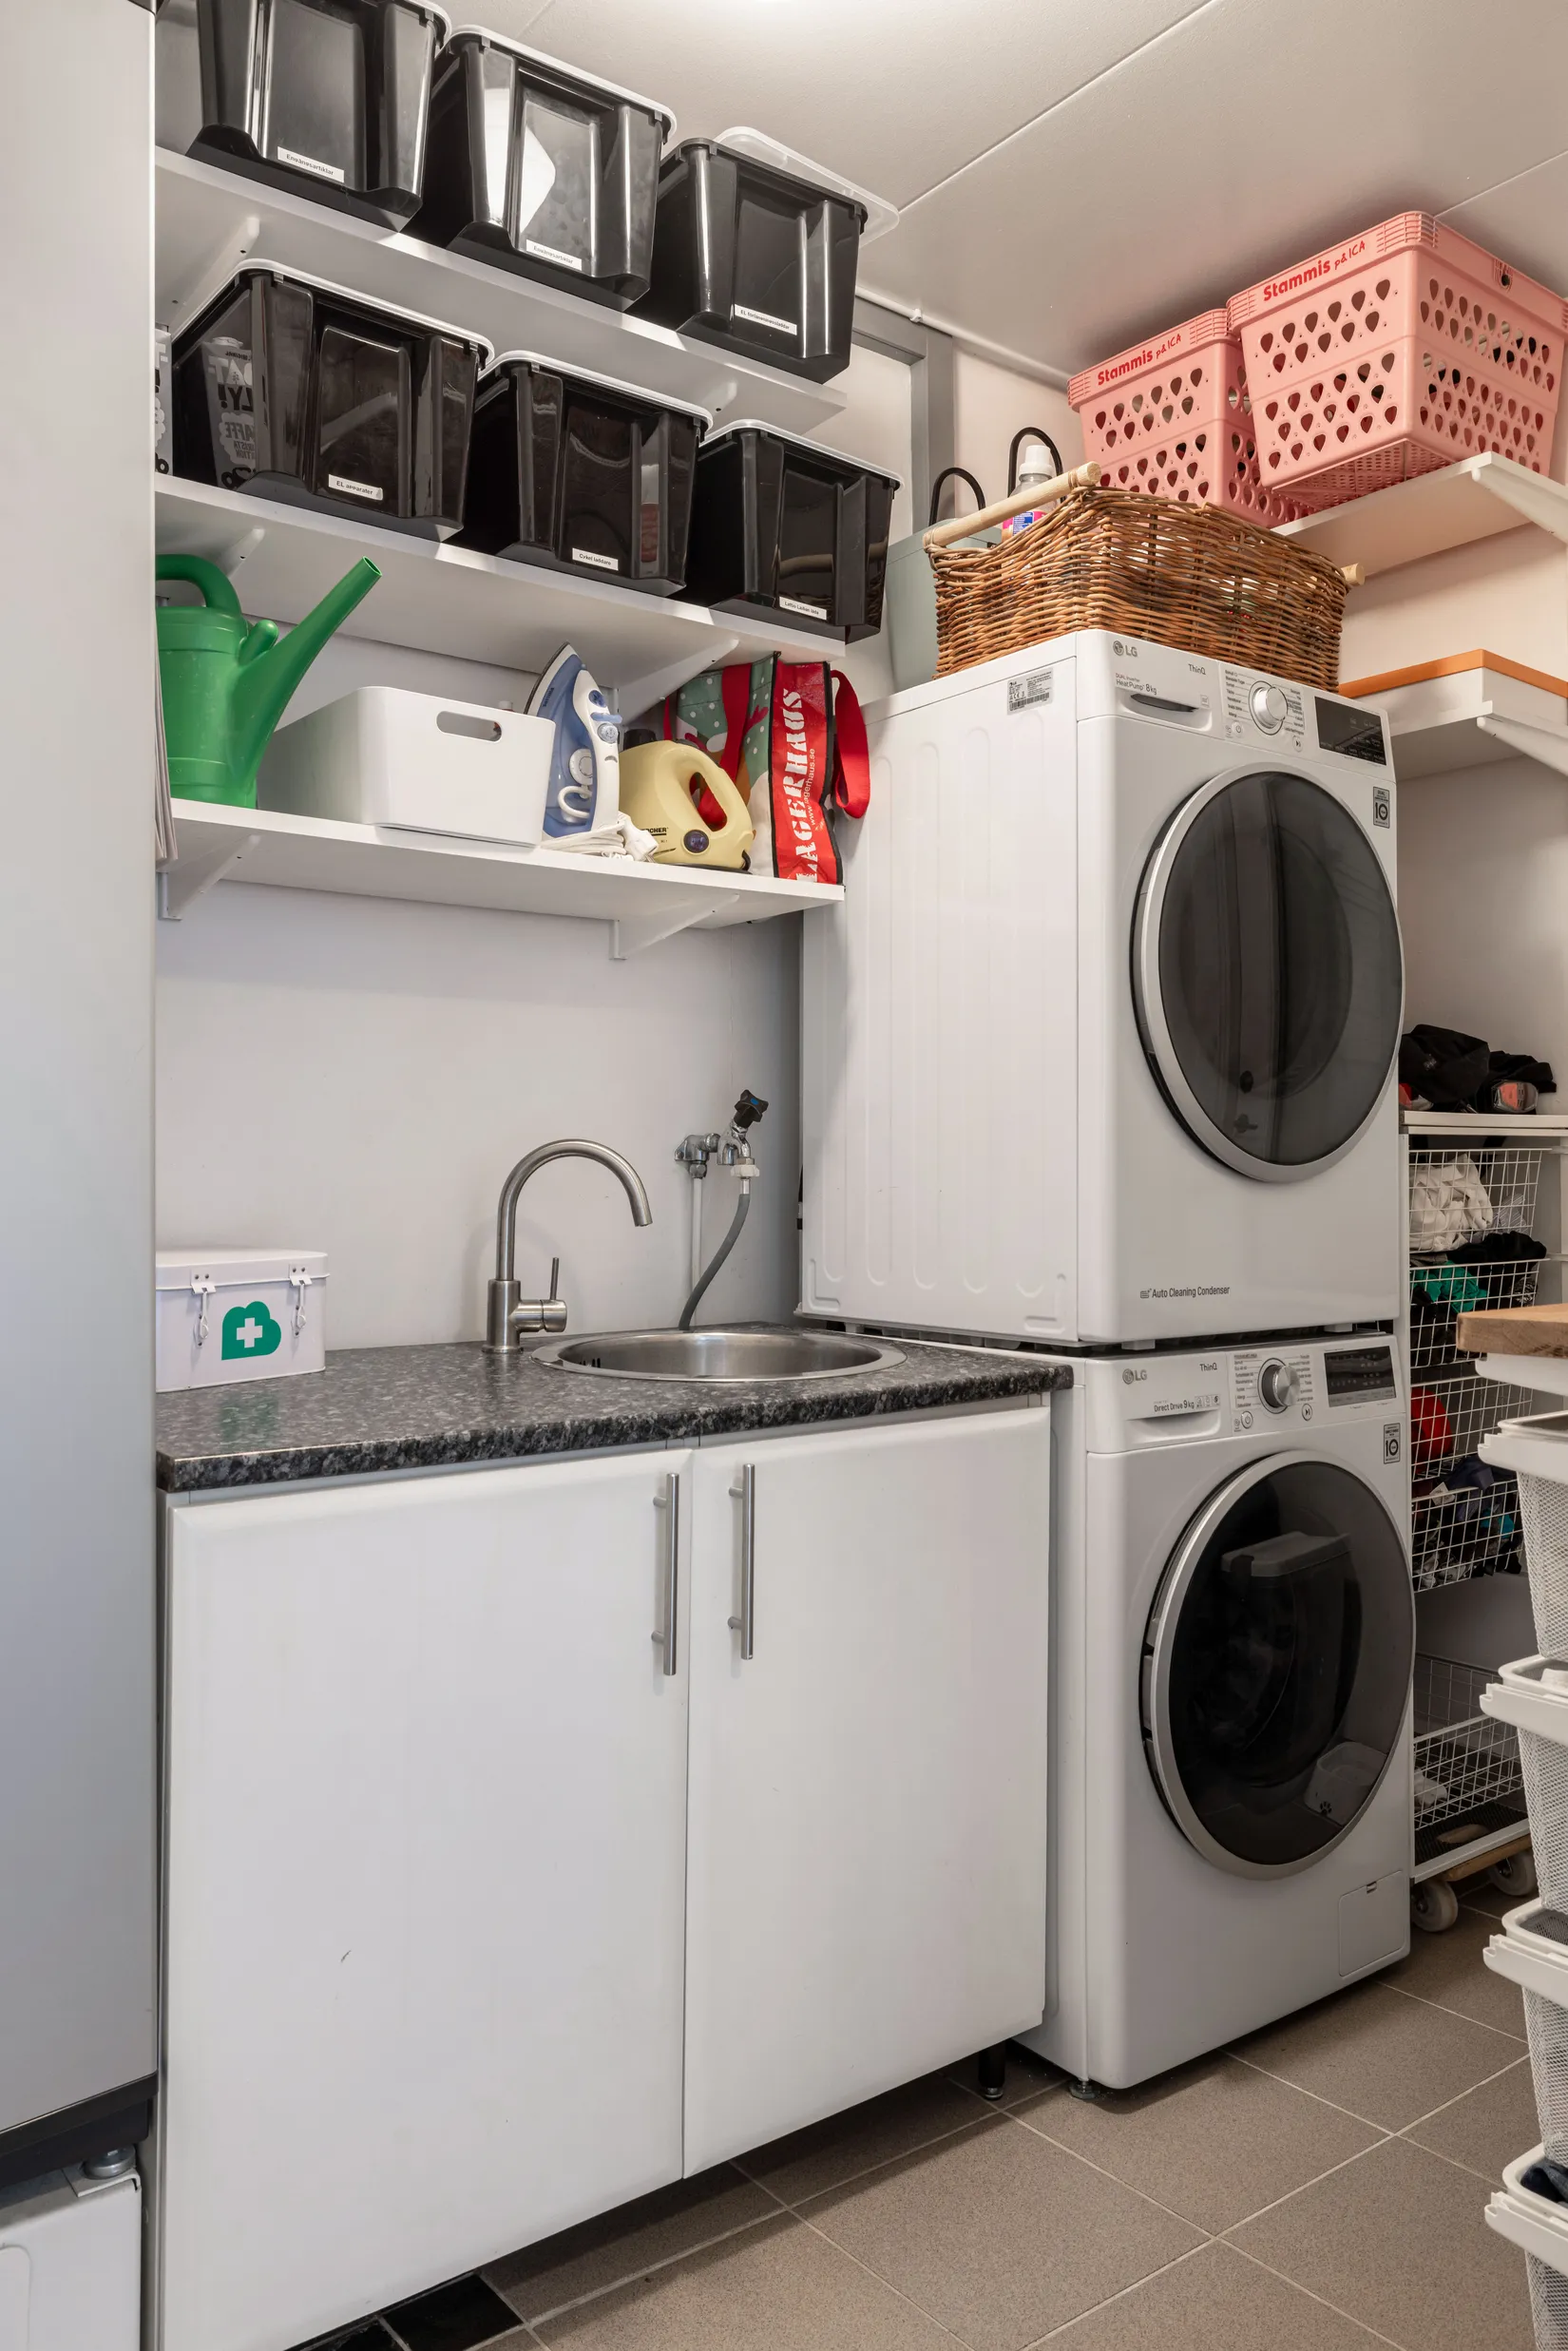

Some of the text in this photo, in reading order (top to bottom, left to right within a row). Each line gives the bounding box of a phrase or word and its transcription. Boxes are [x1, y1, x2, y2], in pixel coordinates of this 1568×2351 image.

[1263, 259, 1331, 301] Stammis
[1348, 240, 1366, 258] ICA
[1098, 350, 1153, 385] Stammis
[1167, 334, 1181, 349] ICA
[335, 480, 373, 496] EL apparater
[1188, 663, 1208, 676] ThinQ
[782, 688, 818, 883] LAGERHAUS
[1375, 802, 1388, 821] 10
[1152, 1286, 1230, 1298] Auto Cleaning Condenser
[1199, 1362, 1217, 1372] ThinQ
[1154, 1404, 1170, 1412] Direct
[1170, 1403, 1183, 1411] Drive
[1386, 1438, 1399, 1457] 10
